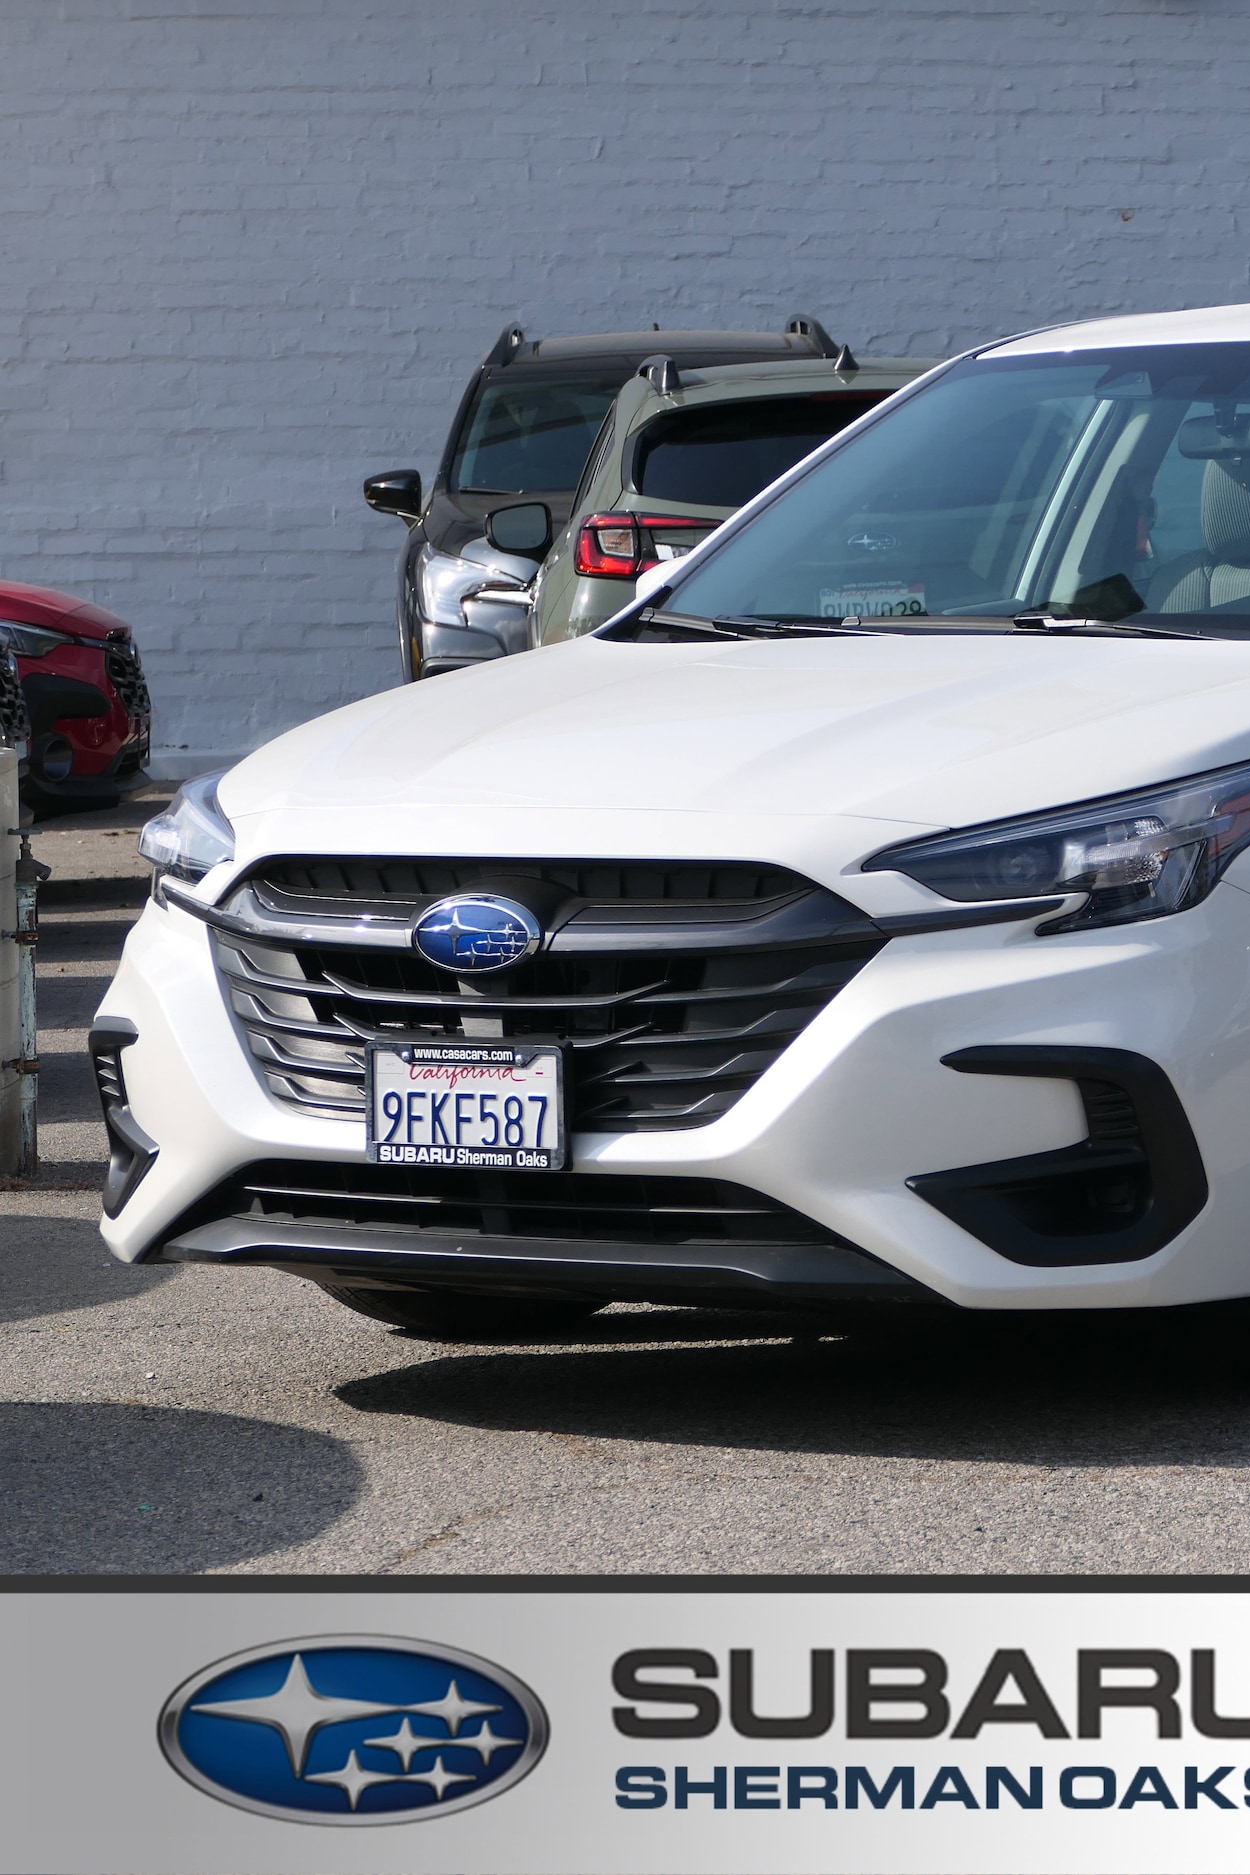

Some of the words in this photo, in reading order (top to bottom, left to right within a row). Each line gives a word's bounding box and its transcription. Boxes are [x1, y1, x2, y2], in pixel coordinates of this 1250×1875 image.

[414, 1048, 513, 1062] www.casacars.com
[409, 1064, 527, 1090] California
[382, 1091, 548, 1148] 9FKF587
[379, 1145, 456, 1164] SUBARU
[456, 1148, 512, 1166] Sherman
[516, 1150, 548, 1168] Oaks
